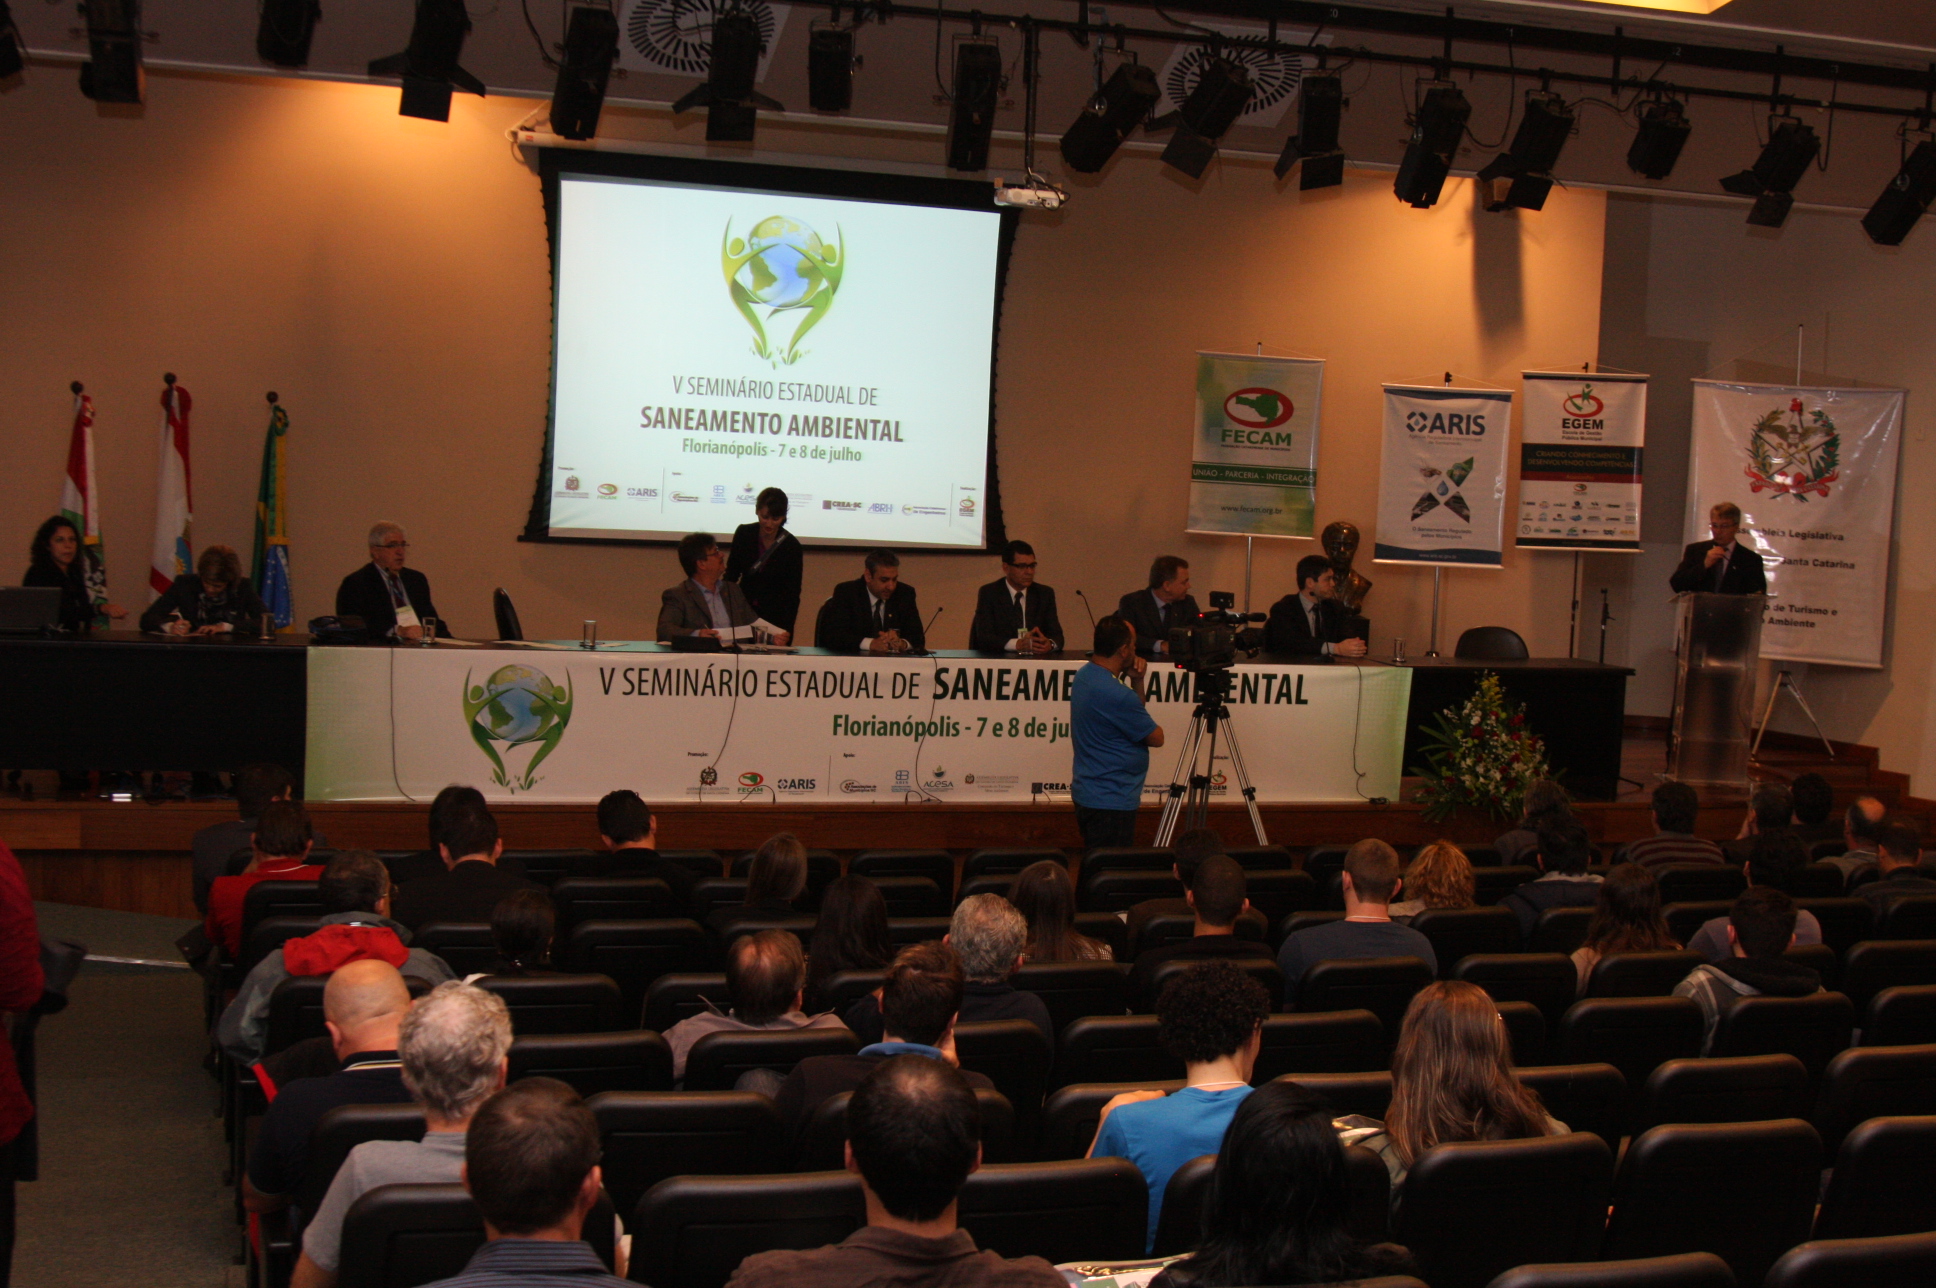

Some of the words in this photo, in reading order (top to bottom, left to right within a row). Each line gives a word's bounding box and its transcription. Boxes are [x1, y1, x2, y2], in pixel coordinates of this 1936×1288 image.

[673, 375, 684, 394] V
[687, 376, 773, 401] SEMINÁRIO
[778, 383, 854, 405] ESTADUAL
[859, 387, 877, 406] DE
[640, 405, 781, 435] SANEAMENTO
[787, 414, 903, 443] AMBIENTAL
[1428, 413, 1485, 435] ARIS
[1562, 419, 1603, 429] EGEM
[1222, 429, 1291, 446] FECAM
[682, 438, 768, 458] Florianópolis
[779, 444, 786, 458] 7
[789, 447, 797, 458] e
[799, 445, 808, 459] 8
[811, 445, 826, 461] de
[828, 446, 862, 463] julho
[1528, 458, 1584, 466] DESENVOLVENDO
[1193, 469, 1217, 477] UNIÃO
[1225, 471, 1259, 479] PARCERIA
[1267, 473, 1314, 484] INTEGRAÇÃO
[635, 489, 657, 497] ARIS
[1221, 505, 1282, 515] www.fecam.org.br
[1789, 530, 1844, 541] Legislativa
[1782, 557, 1809, 566] Santa
[1813, 559, 1855, 569] Catarina
[1774, 603, 1786, 611] de
[1789, 605, 1828, 615] Turismo
[1768, 617, 1816, 628] Ambiente
[600, 668, 615, 695] V
[623, 664, 758, 697] SEMINÁRIO
[767, 670, 883, 699] ESTADUAL
[892, 672, 920, 699] DE
[934, 667, 1077, 701] SANEAME
[1145, 671, 1308, 705] AMENTAL
[833, 714, 960, 742] Florianópolis
[977, 717, 988, 737] 7
[992, 722, 1003, 737] e
[1008, 718, 1019, 737] 8
[1025, 716, 1047, 738] de
[789, 779, 816, 789] ARIS
